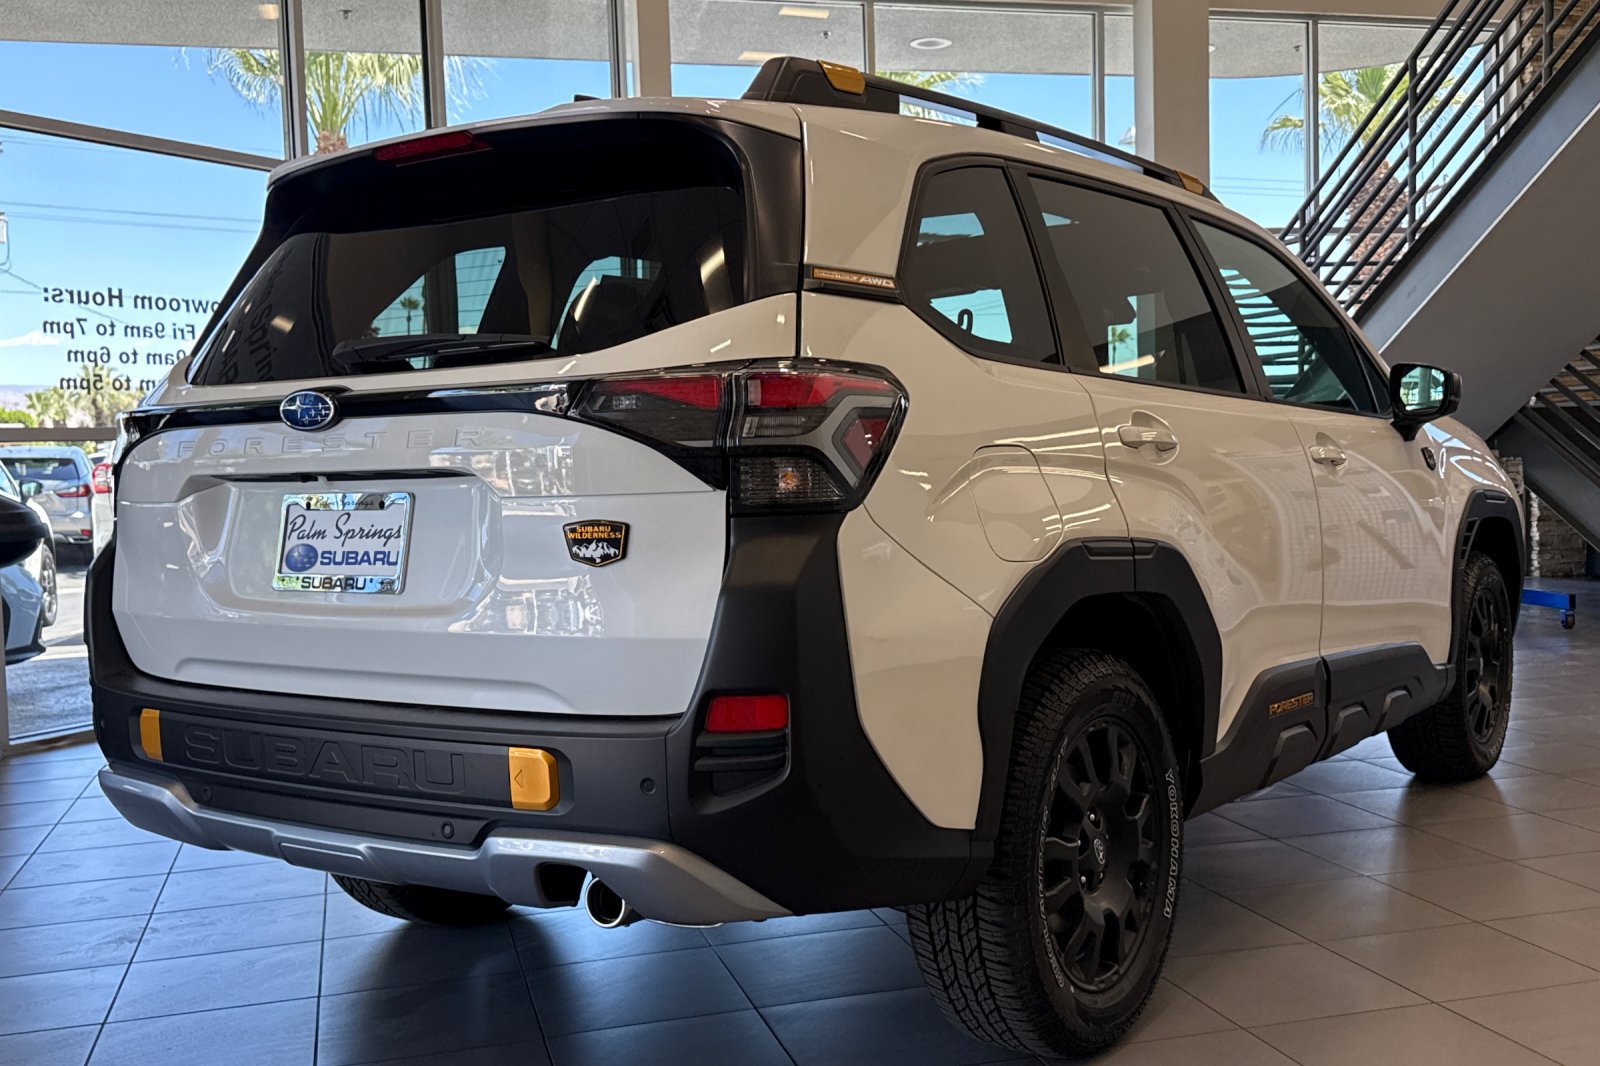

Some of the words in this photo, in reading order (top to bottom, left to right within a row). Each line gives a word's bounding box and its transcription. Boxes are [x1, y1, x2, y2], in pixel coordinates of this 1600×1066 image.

[860, 276, 896, 288] AWD
[178, 427, 483, 456] FORESTER
[288, 514, 328, 541] Palm
[333, 512, 402, 547] Springs
[320, 551, 399, 565] SUBARU
[300, 577, 367, 590] SUBARU
[1269, 692, 1314, 716] FORESTER
[184, 724, 465, 794] SUBARU
[1163, 768, 1181, 919] YOKOHAMA
